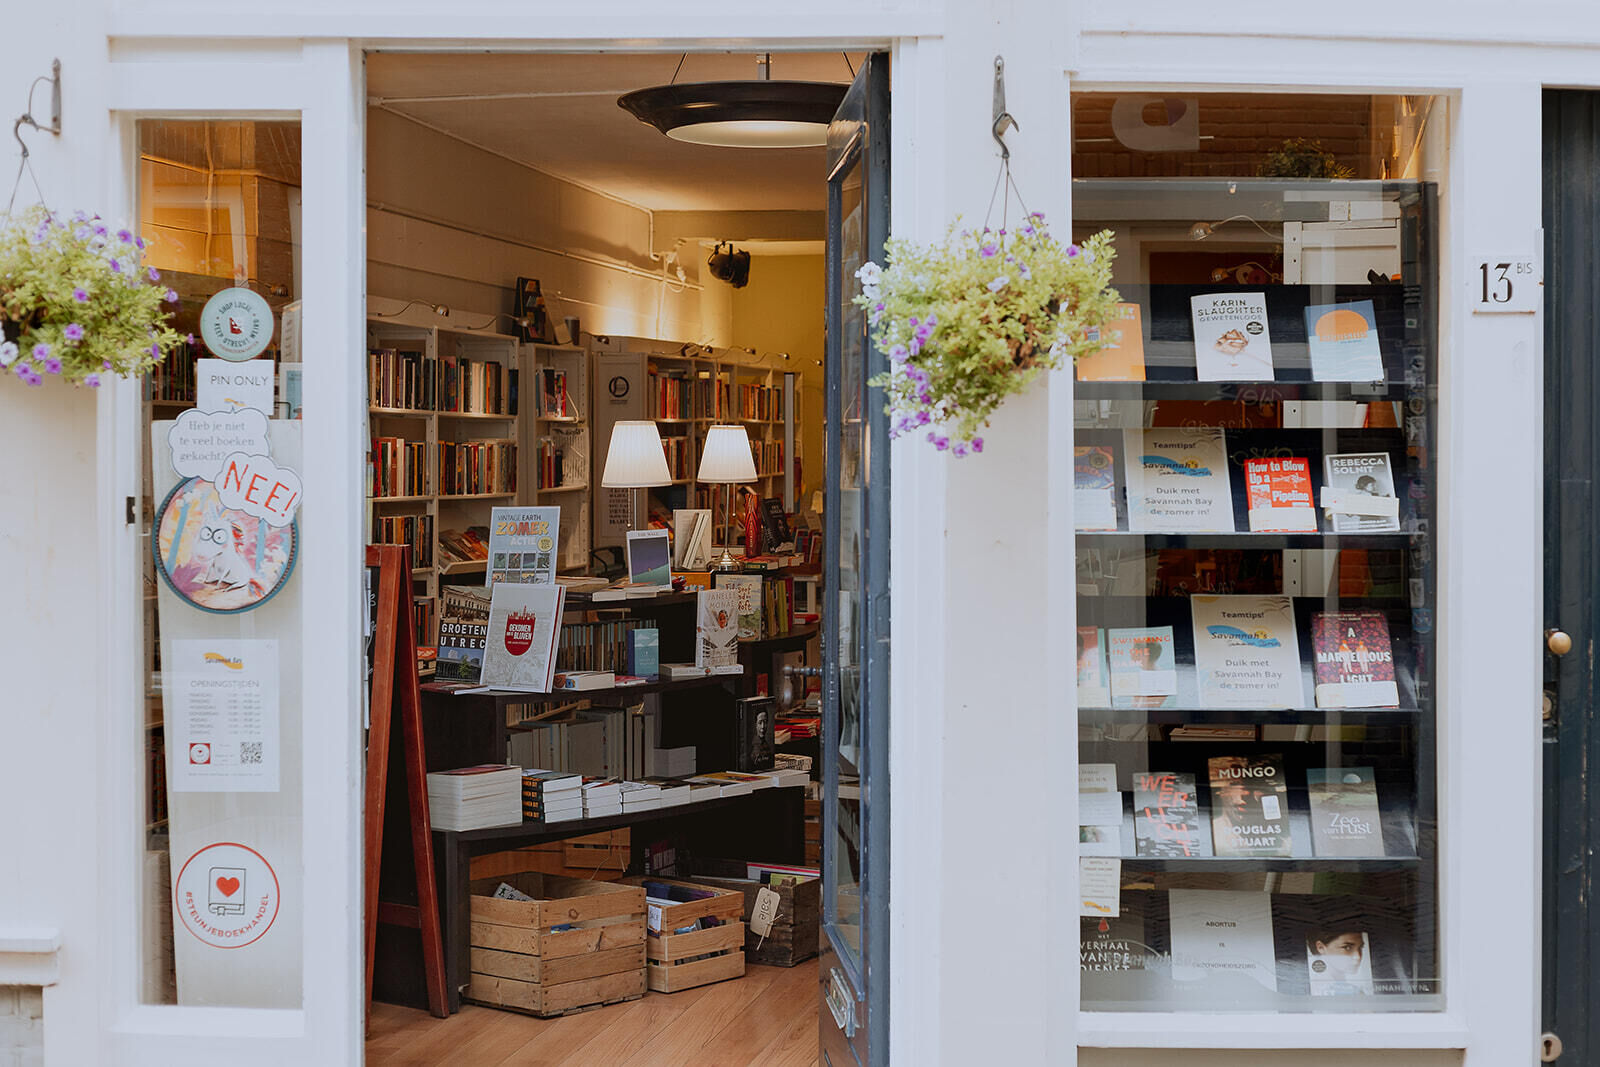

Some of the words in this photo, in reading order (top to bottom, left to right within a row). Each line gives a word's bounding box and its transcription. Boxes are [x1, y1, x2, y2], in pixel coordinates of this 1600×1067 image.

[1516, 262, 1533, 274] BIS
[1480, 263, 1512, 302] 13
[219, 302, 233, 315] SHOP
[234, 301, 252, 314] LOCAL
[1212, 299, 1247, 307] KARIN
[1197, 306, 1264, 317] SLAUGHTER
[1199, 314, 1263, 322] GEWETENLOOS
[210, 375, 230, 386] PIN
[233, 375, 269, 387] ONLY
[189, 420, 210, 431] Heb
[212, 420, 223, 434] je
[225, 420, 246, 431] niet
[179, 436, 190, 446] te
[192, 436, 214, 446] veel
[216, 436, 255, 446] boeken
[1153, 442, 1196, 450] Teamtips!
[179, 452, 226, 463] gekocht?
[1332, 458, 1385, 467] REBECCA
[1143, 461, 1199, 470] Savannah's
[1248, 462, 1268, 473] How
[1269, 461, 1281, 472] to
[1282, 460, 1305, 472] Blow
[1333, 466, 1374, 475] SOLNIT
[1249, 473, 1263, 485] Up
[1264, 474, 1271, 483] a
[223, 460, 298, 518] NEE!
[1145, 497, 1193, 505] Savannah
[1195, 497, 1213, 506] Bay
[1272, 490, 1310, 503] Pipeline
[495, 522, 549, 536] ZOMER
[510, 537, 537, 547] ACTIE
[1222, 611, 1265, 620] Teamtips!
[441, 623, 487, 636] GROETEN
[1347, 627, 1356, 638] A
[1211, 631, 1268, 640] Savannah's
[1112, 648, 1125, 656] IN
[1316, 651, 1392, 663] MARVELLOUS
[1250, 659, 1270, 667] met
[1215, 670, 1263, 679] Savannah
[1265, 670, 1283, 680] Bay
[1340, 674, 1374, 684] LIGHT
[190, 679, 260, 689] OPENINGSTIJDEN
[1218, 766, 1276, 780] MUNGO
[1141, 775, 1176, 792] WE
[1157, 791, 1188, 808] ER
[1328, 812, 1361, 828] Zee
[1224, 824, 1282, 836] DOUGLAS
[1230, 836, 1277, 848] STUART
[185, 891, 270, 938] #STEUNJEBOEKHANDEL
[1080, 940, 1130, 950] VERHAAL
[1080, 951, 1107, 962] VAN
[1113, 951, 1131, 962] DE
